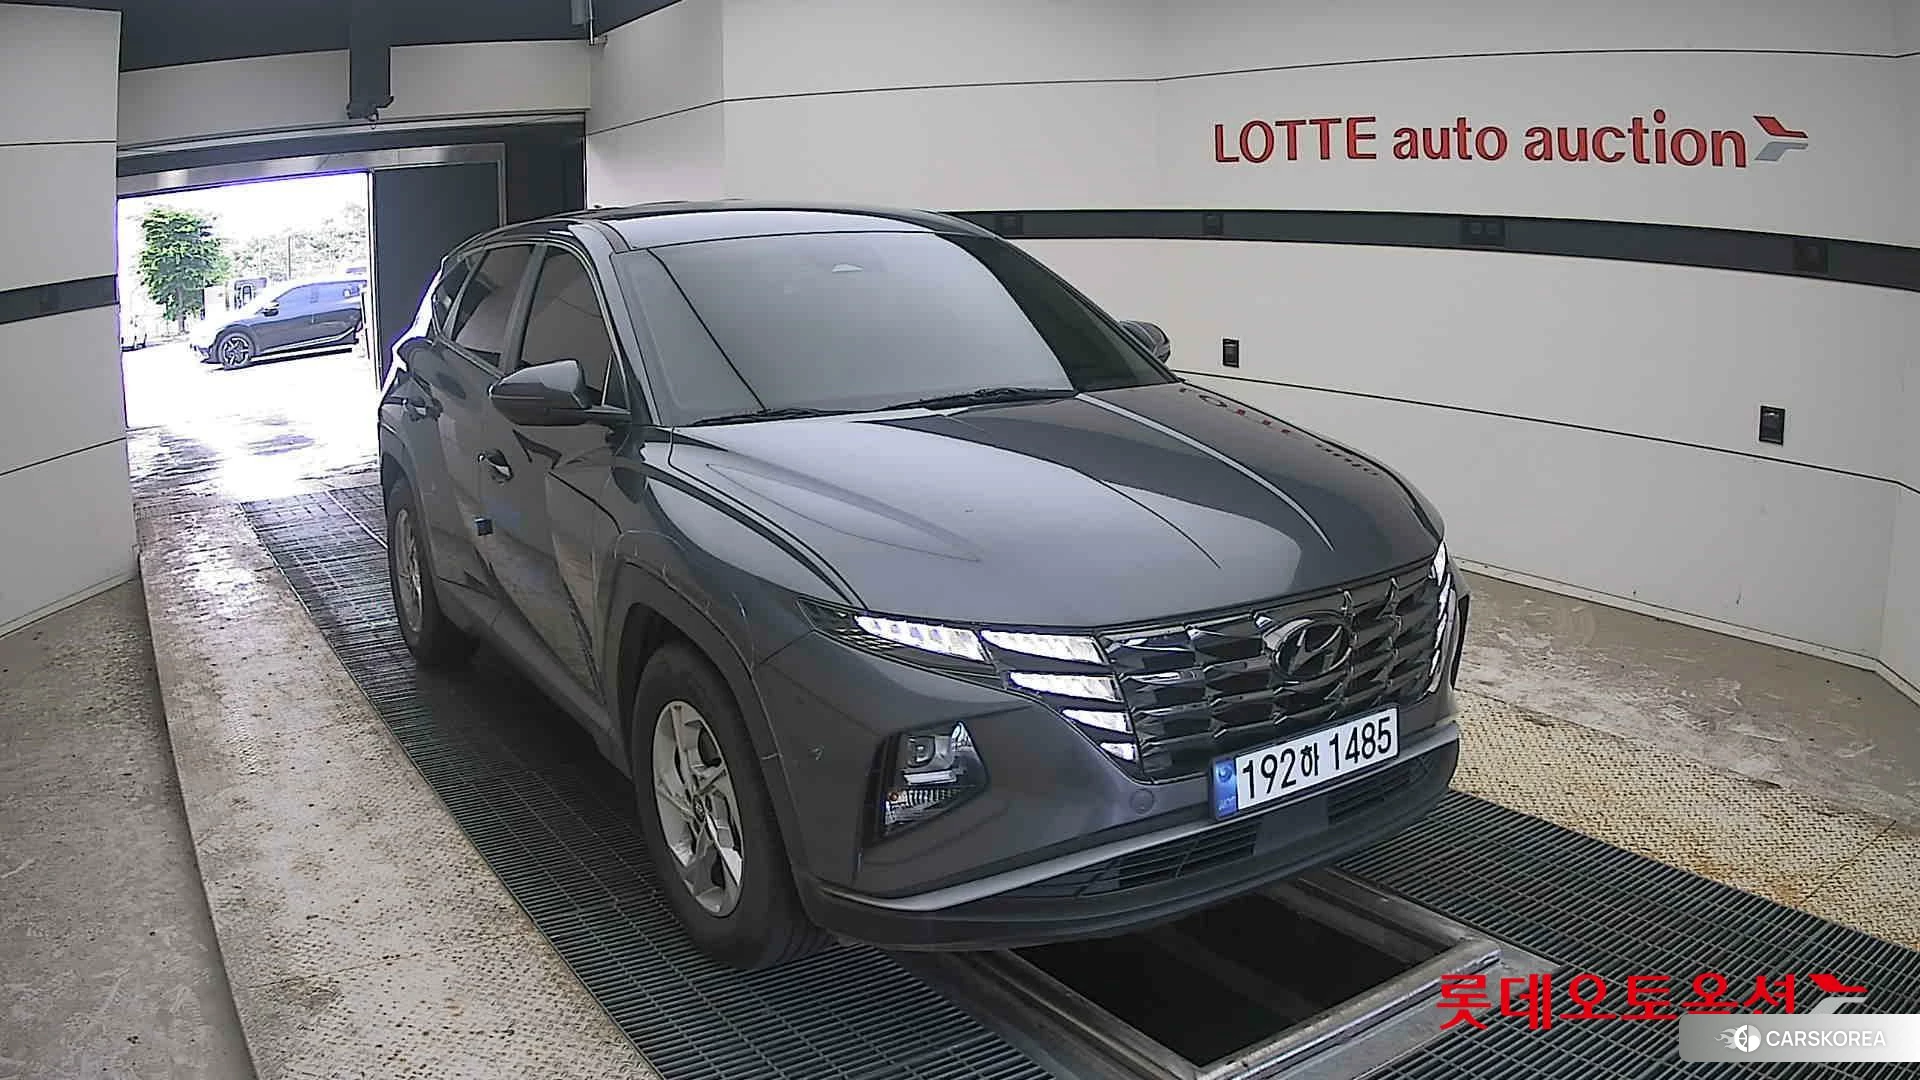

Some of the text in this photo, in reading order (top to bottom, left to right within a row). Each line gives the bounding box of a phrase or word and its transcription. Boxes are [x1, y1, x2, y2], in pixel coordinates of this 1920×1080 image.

[1214, 109, 1748, 168] LOTTE auto auction
[1242, 716, 1392, 799] 192하 1485
